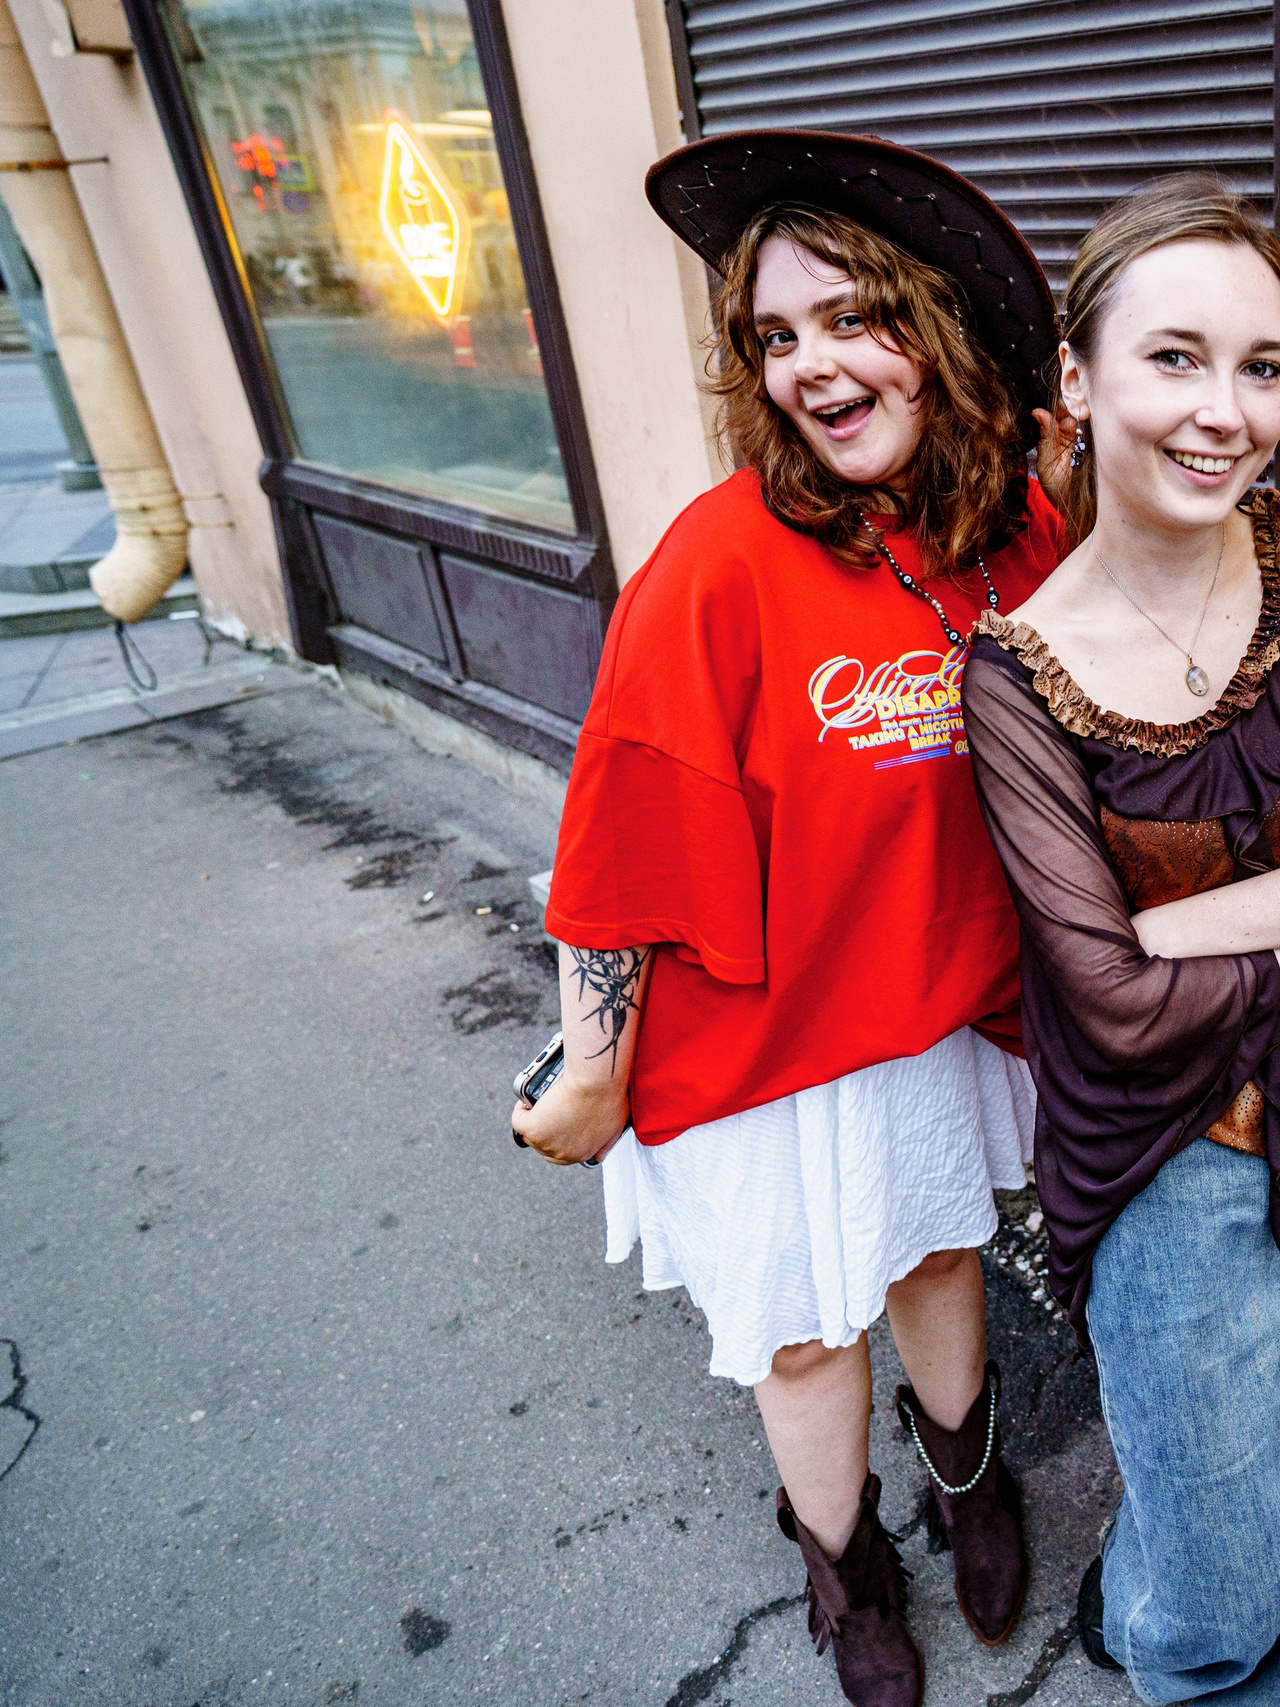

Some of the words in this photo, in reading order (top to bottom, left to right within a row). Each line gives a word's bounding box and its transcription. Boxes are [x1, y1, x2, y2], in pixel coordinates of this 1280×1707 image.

[848, 728, 906, 750] TAKING
[907, 725, 920, 739] A
[908, 731, 953, 752] BREAK
